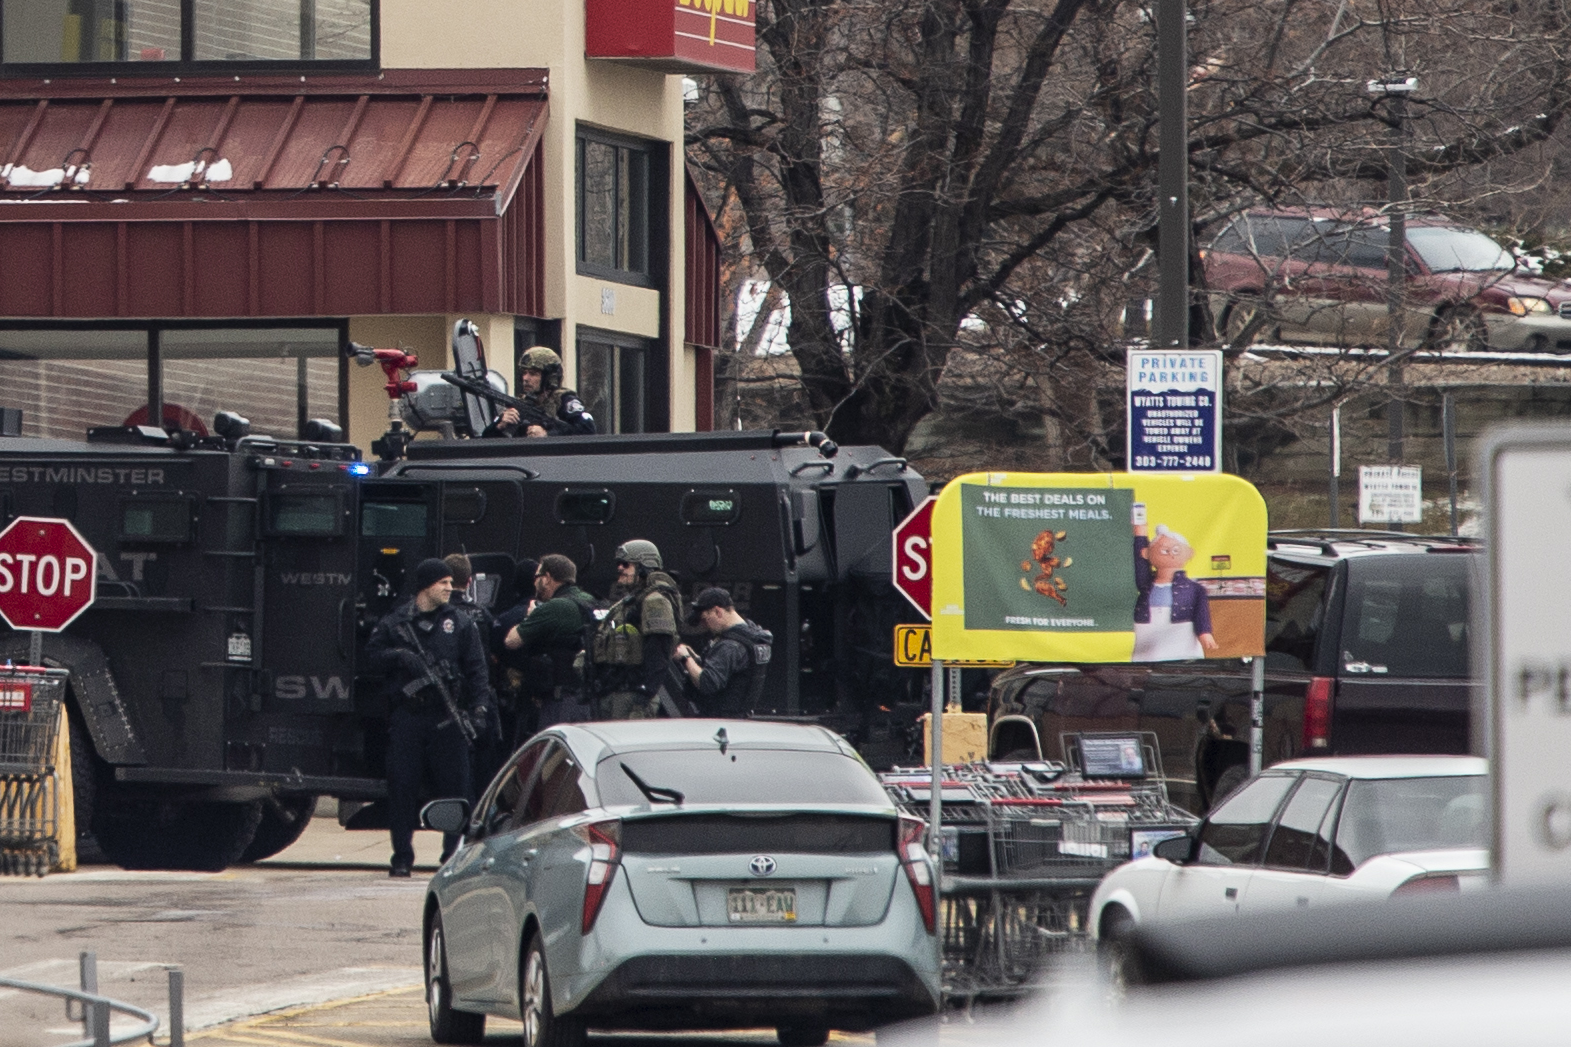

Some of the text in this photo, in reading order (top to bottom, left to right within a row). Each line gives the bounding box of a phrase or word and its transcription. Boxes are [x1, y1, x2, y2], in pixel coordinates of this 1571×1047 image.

[1141, 357, 1206, 369] PRIVATE
[1139, 371, 1208, 383] PARKING
[1133, 395, 1164, 407] WYATTS
[1166, 395, 1196, 407] TOWING
[983, 491, 1106, 505] THE BEST DEALS ON
[976, 506, 1113, 520] THE FRESHEST MEALS.
[1005, 616, 1032, 626] FRESH
[1032, 617, 1050, 626] FOR
